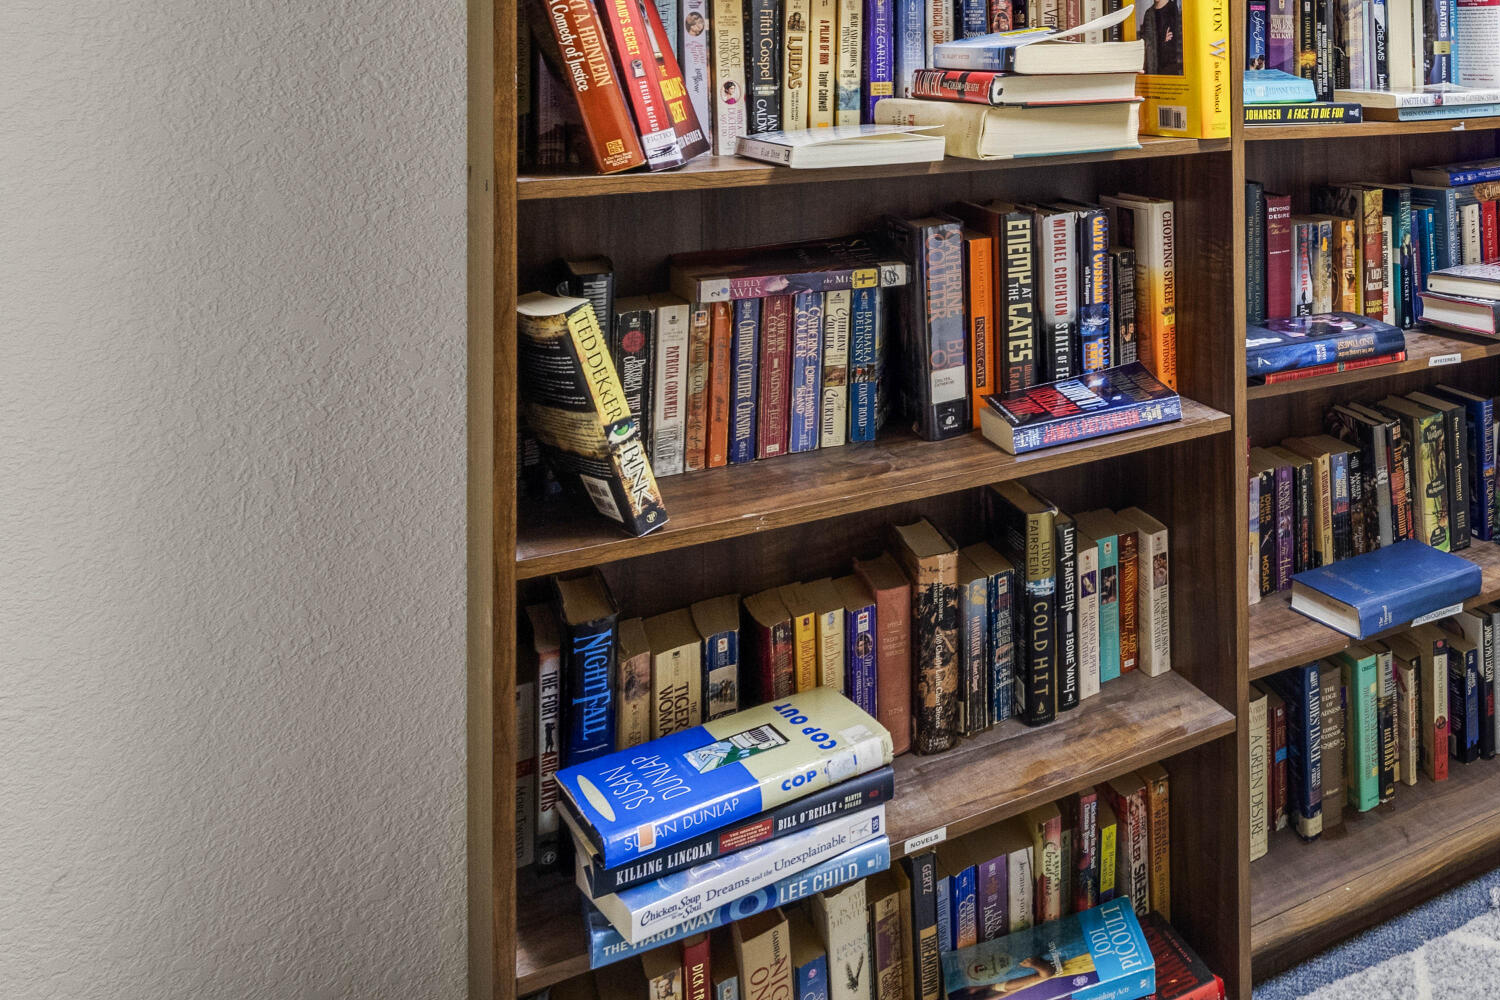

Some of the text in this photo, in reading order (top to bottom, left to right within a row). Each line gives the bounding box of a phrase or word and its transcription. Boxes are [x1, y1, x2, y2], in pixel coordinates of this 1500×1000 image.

[551, 3, 573, 46] Comedy
[568, 55, 589, 91] Justice
[579, 25, 612, 87] HEINLEIN
[623, 24, 640, 55] SECRET
[757, 9, 774, 81] Fifth Gospel
[876, 18, 886, 78] LIZ CARLYLE
[917, 72, 944, 96] LOWELL
[1213, 86, 1222, 113] Wasted
[1246, 108, 1343, 120] JOHANSEN A FACE TO DIE FOR
[1007, 219, 1031, 298] ENEMY AT
[1053, 219, 1067, 316] MICHAEL CRICHTON
[1162, 211, 1174, 304] CHOPPING SPREE
[855, 312, 864, 362] DELINSKY
[1008, 282, 1032, 362] THE GATES
[1056, 323, 1069, 364] STATE OF
[574, 312, 622, 423] TED DEKKER
[664, 345, 679, 420] PATRICIA CORNWELL
[858, 383, 868, 405] COAST
[1061, 528, 1075, 614] LINDA FAIRSTEIN
[1031, 601, 1049, 658] COLD
[1065, 639, 1074, 664] BONE
[540, 670, 559, 721] THE FORT
[573, 628, 612, 740] NIGHTFALL
[803, 727, 837, 749] COP
[1310, 728, 1320, 762] LUNCH
[600, 767, 653, 811] SUSAN
[632, 754, 692, 801] DUNLAP
[781, 770, 818, 791] COP
[1251, 734, 1264, 839] A GREEN DESIRE
[624, 798, 740, 851] SUAN DUNLAP
[778, 802, 837, 831] BILL O'REILLY
[1130, 804, 1142, 863] SPINDLER
[616, 842, 713, 886] KILLING LINCOLN
[752, 836, 846, 882] and the Unexplainable
[910, 833, 939, 849] NOVELS
[706, 876, 750, 901] Dreams
[780, 863, 858, 904] LEE CHILD
[921, 864, 932, 895] GERTZ
[603, 910, 717, 957] THE WAY
[641, 894, 701, 926] Chicken Soup
[1089, 928, 1111, 959] JODI
[1101, 905, 1139, 971] PICOULT
